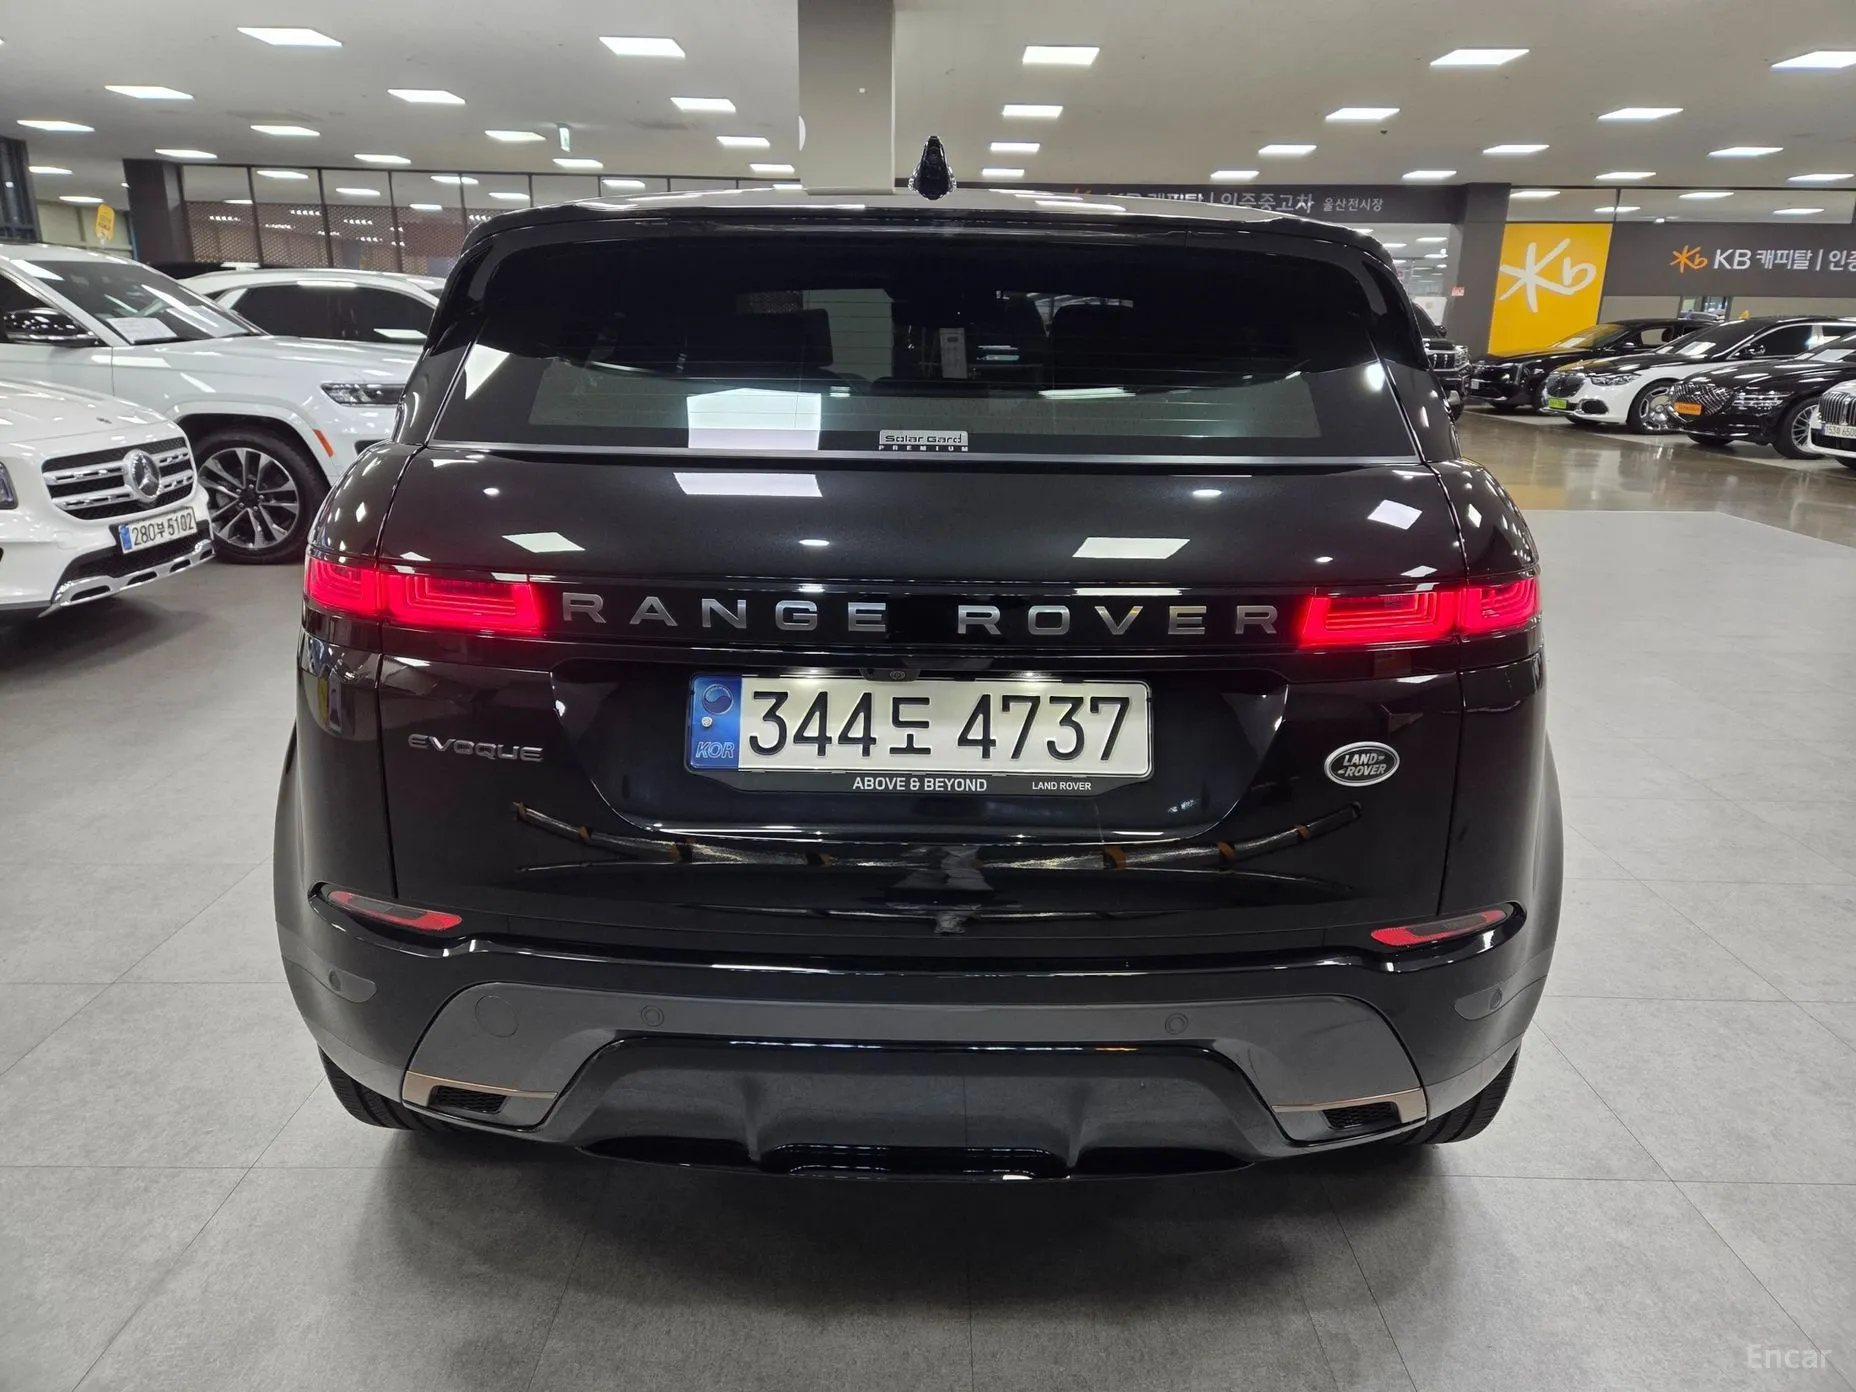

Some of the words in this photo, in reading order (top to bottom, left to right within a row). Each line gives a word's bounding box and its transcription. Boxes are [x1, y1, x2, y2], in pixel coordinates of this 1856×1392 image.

[1323, 197, 1385, 213] 울산전시장
[1713, 249, 1752, 270] KB
[1756, 249, 1813, 270] 캐피탈
[884, 434, 924, 443] Solar
[926, 433, 962, 444] Gard
[879, 444, 968, 452] PREMIUM
[132, 521, 165, 546] 280부
[167, 512, 194, 536] 5102
[562, 591, 888, 632] RANGE
[957, 604, 1279, 636] ROVER
[749, 690, 932, 758] 344도
[957, 693, 1131, 761] 4737
[408, 733, 544, 762] EVOQUE
[695, 741, 735, 759] KOR
[1343, 752, 1378, 767] LAND
[1344, 763, 1387, 777] ROVER
[853, 776, 906, 791] ABOVE
[909, 777, 921, 790] &
[924, 778, 987, 792] BEYOND
[1032, 781, 1058, 791] LAND
[1060, 781, 1092, 791] ROVER
